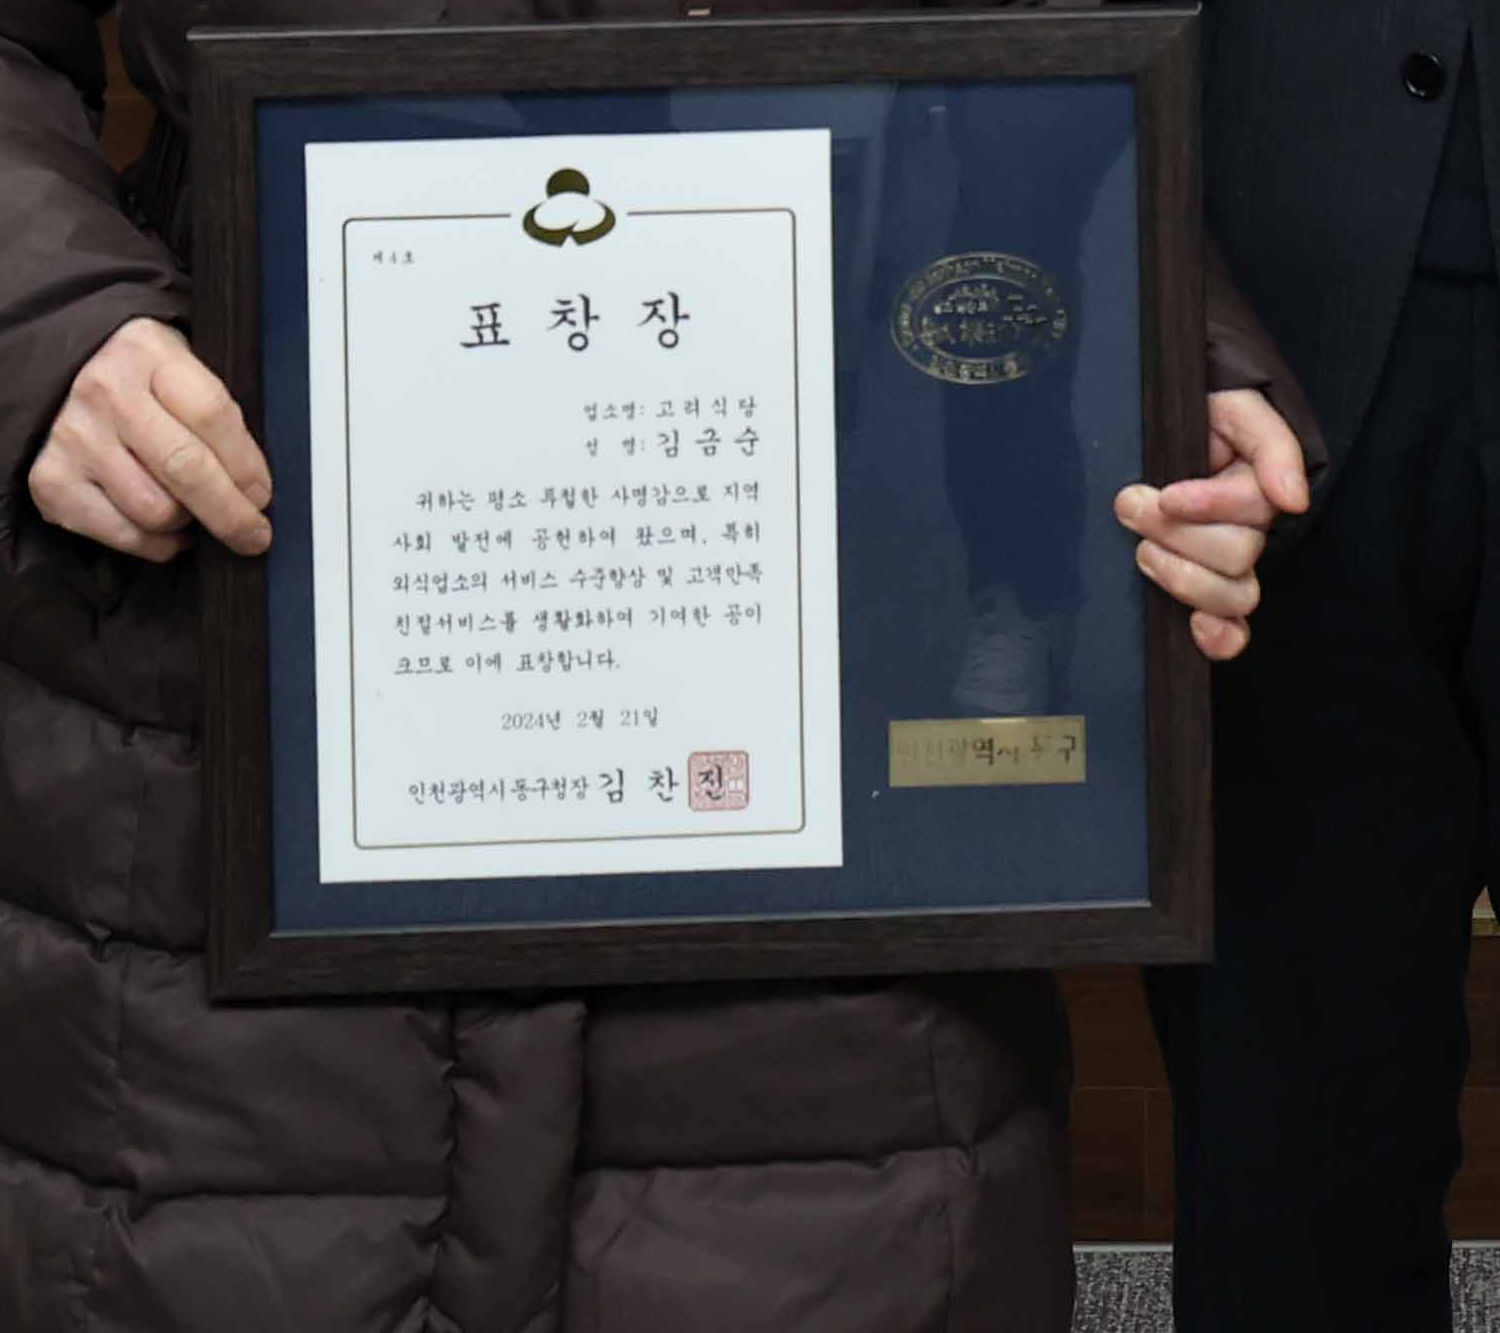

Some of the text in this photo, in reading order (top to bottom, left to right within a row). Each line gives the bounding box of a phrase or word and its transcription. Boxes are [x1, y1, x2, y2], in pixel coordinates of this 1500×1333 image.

[416, 489, 475, 512] 귀하는
[487, 488, 527, 512] 평소
[611, 484, 711, 508] 사명감으로
[723, 480, 759, 502] 지역
[394, 531, 432, 553] 사회
[451, 528, 513, 554] 발전에
[532, 525, 616, 551] 공헌하여
[721, 521, 760, 544] 특히
[392, 570, 488, 595] 외식업소의
[501, 569, 558, 591] 서비스
[656, 564, 673, 587] 및
[533, 607, 633, 633] 생활화하여
[649, 604, 711, 628] 기여한
[723, 602, 762, 627] 공이
[394, 648, 621, 676] 크므로 이에 표창합니다.
[501, 705, 658, 732] 2024년 2월 21일
